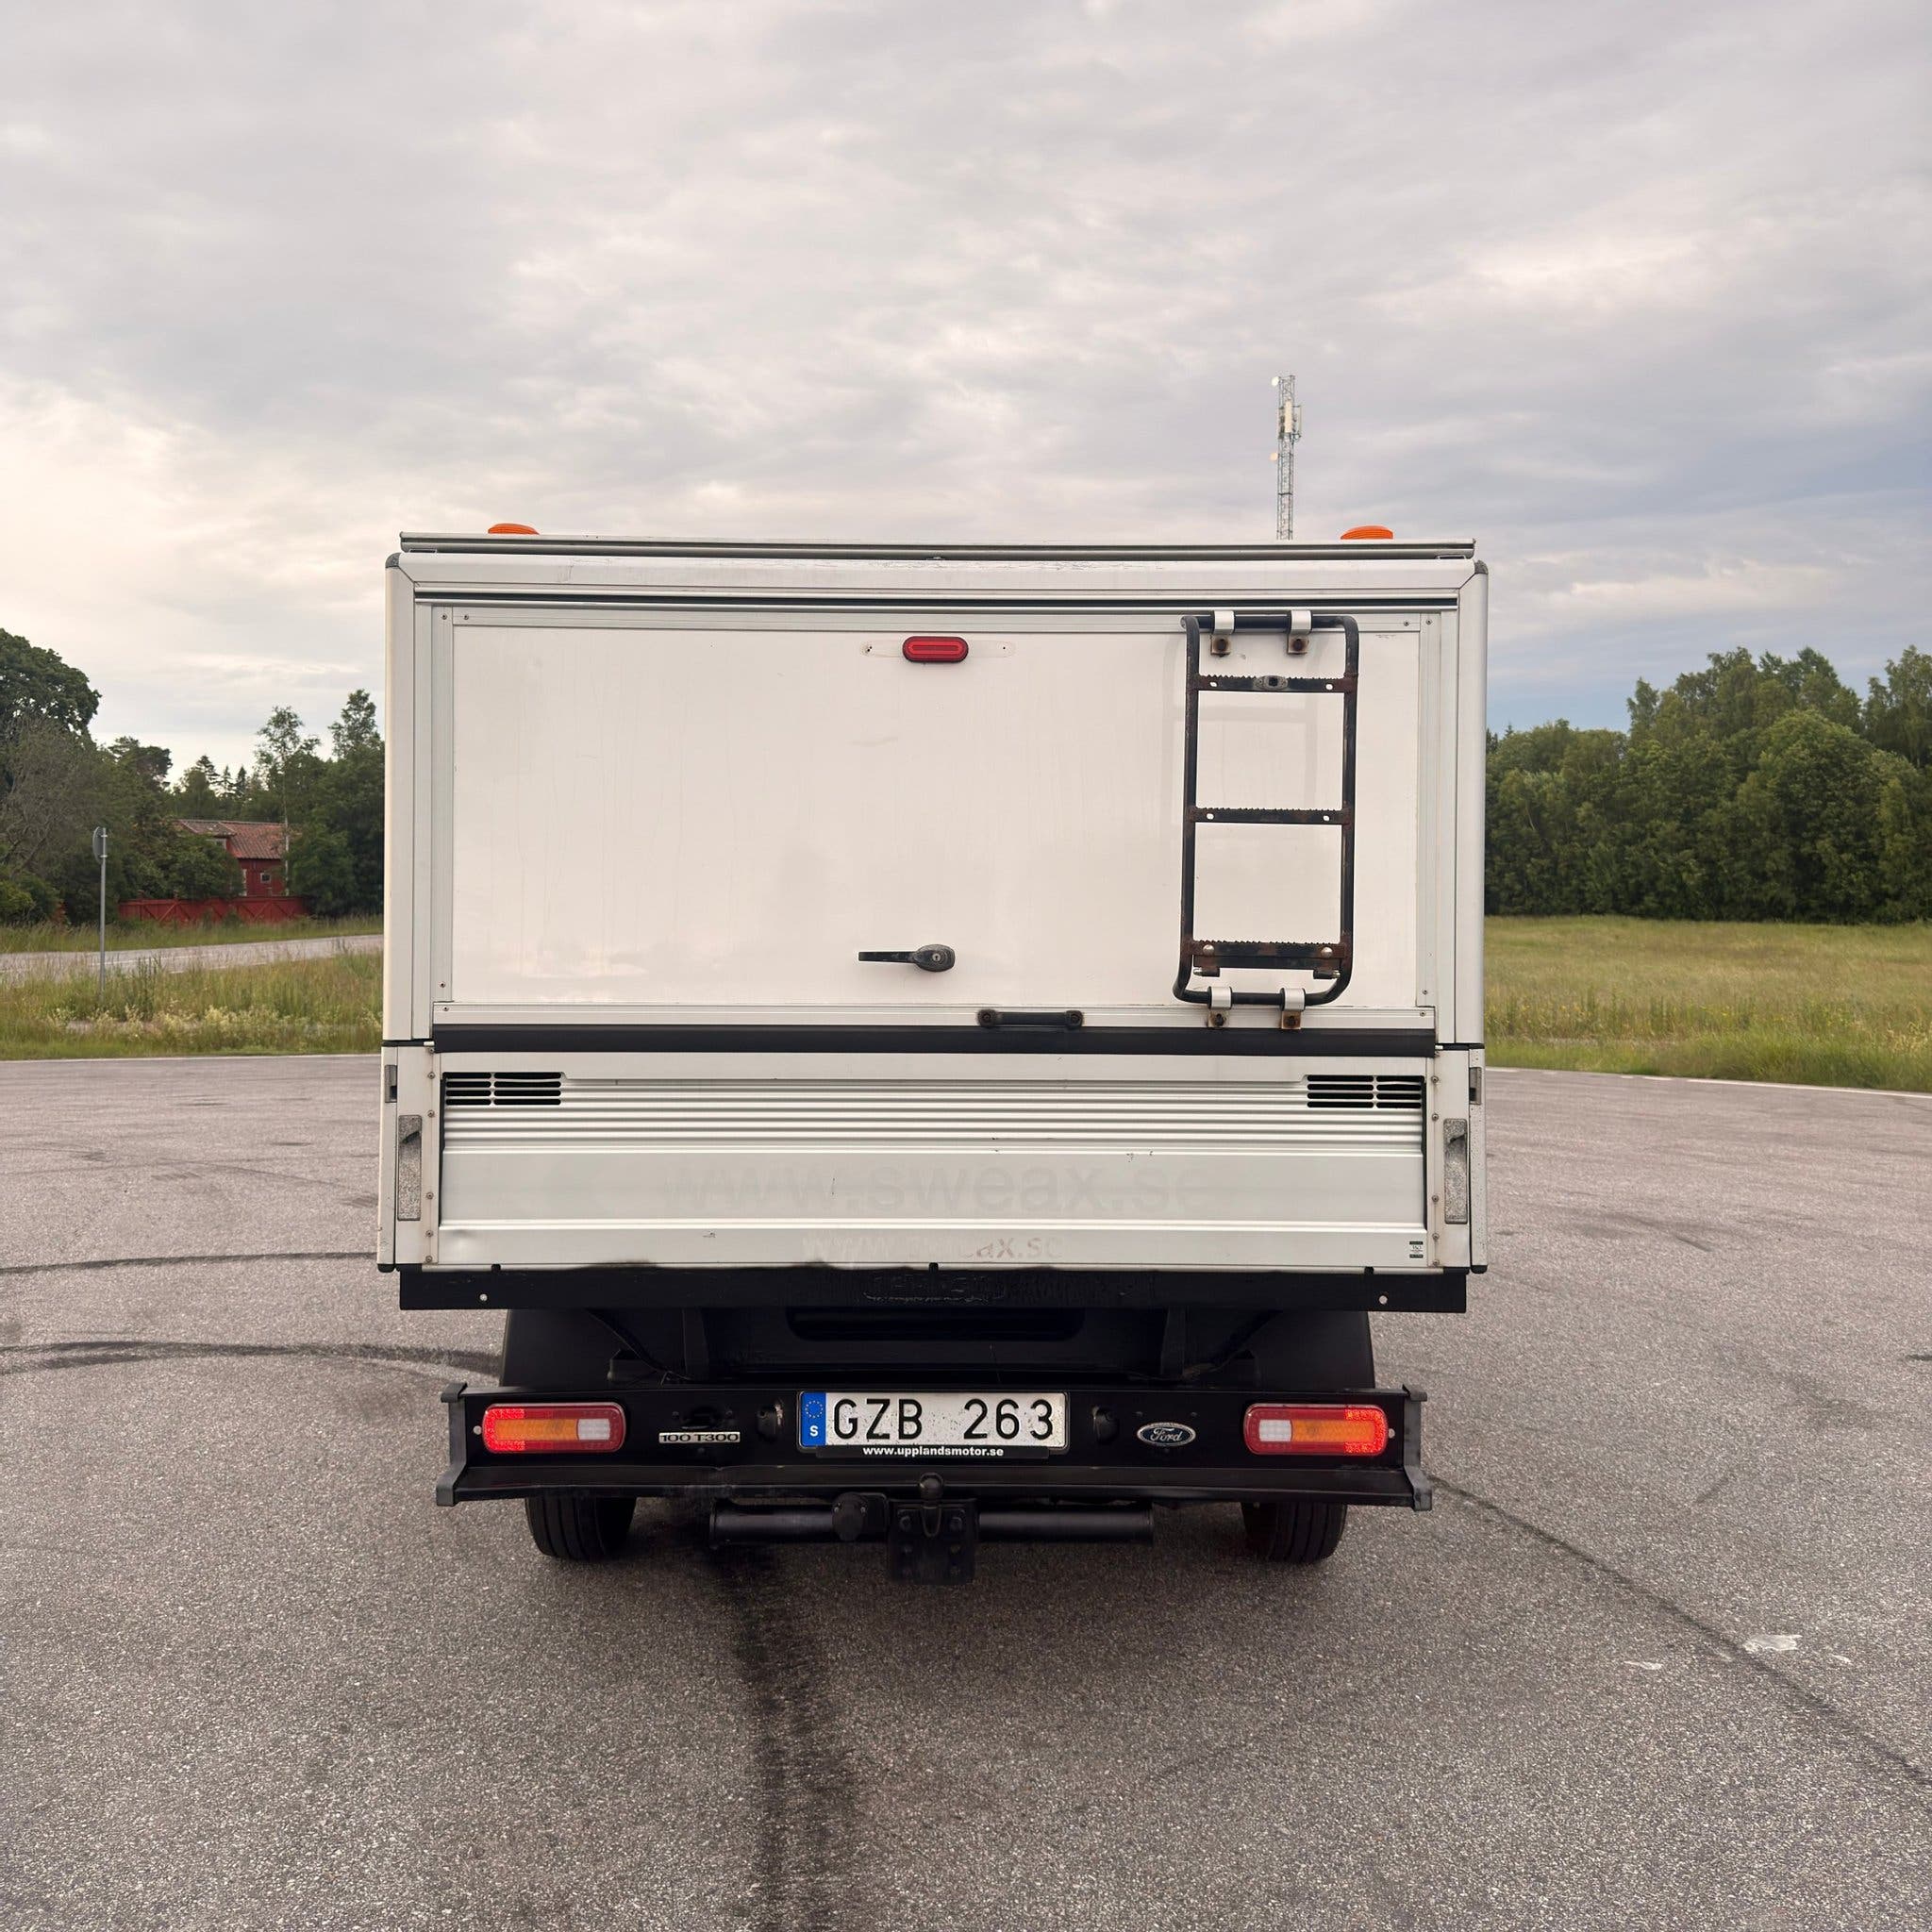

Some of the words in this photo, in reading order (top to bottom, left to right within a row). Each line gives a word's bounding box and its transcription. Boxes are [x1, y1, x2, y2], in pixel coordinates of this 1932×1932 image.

[834, 1398, 923, 1441] GZB
[964, 1398, 1053, 1441] 263
[809, 1424, 819, 1437] S
[1150, 1426, 1183, 1442] Ford
[660, 1434, 691, 1442] 100
[694, 1433, 740, 1442] T300
[862, 1446, 1005, 1457] www.upplandsmotor.se
